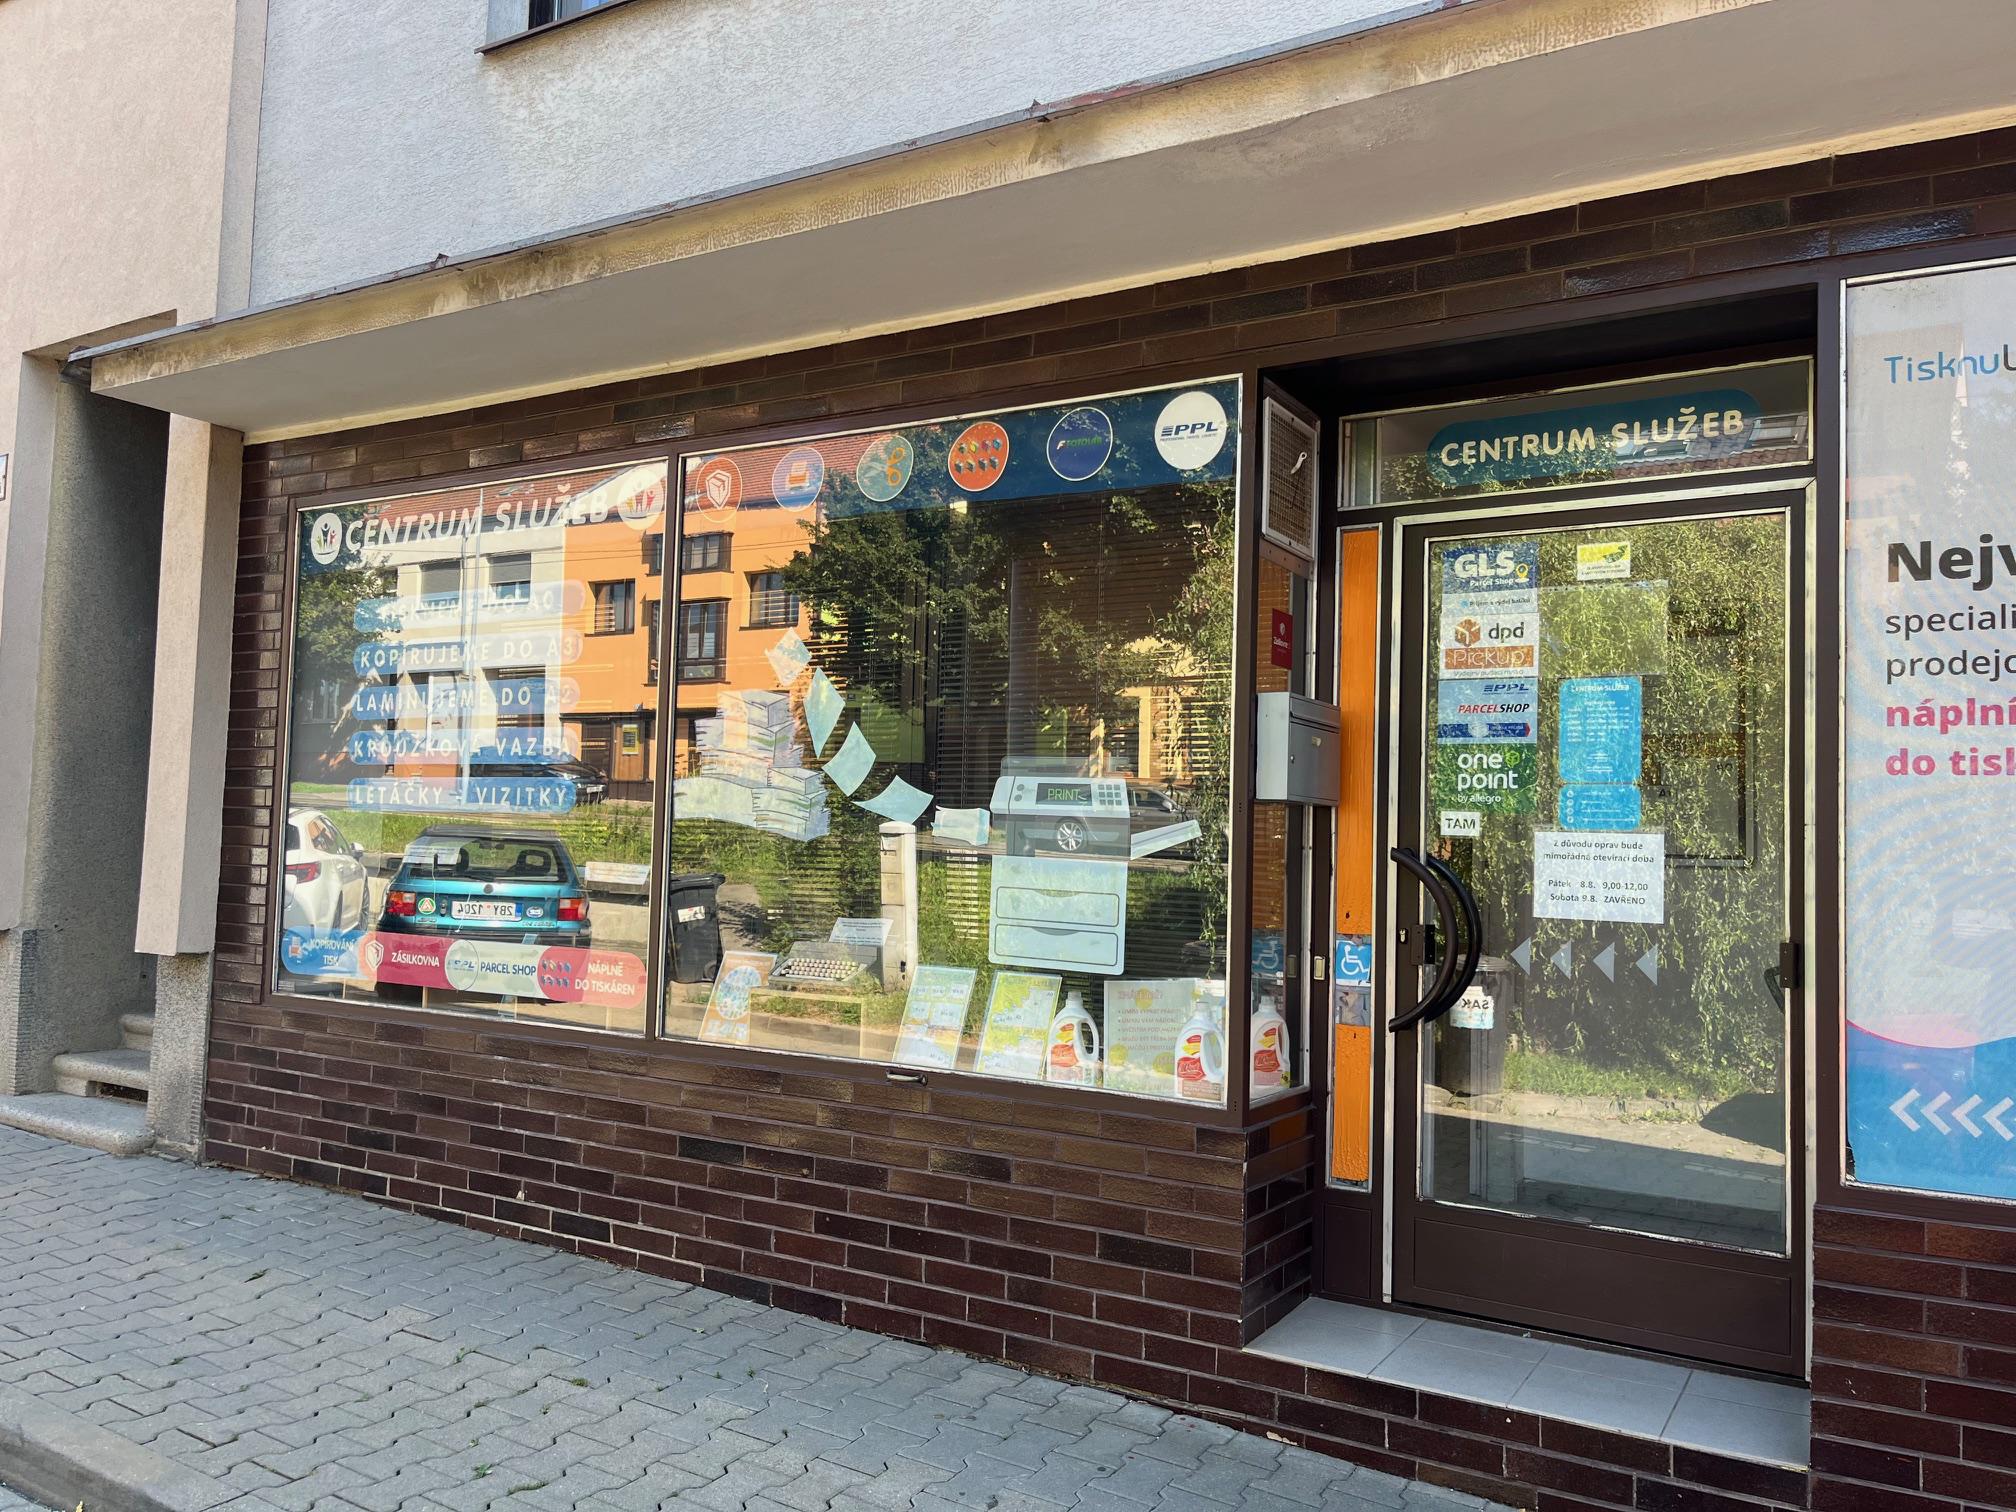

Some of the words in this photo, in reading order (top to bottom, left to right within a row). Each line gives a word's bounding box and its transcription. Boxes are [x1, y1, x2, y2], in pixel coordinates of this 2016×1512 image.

[1173, 421, 1219, 436] PPL
[1440, 427, 1596, 467] CENTRUM
[1610, 405, 1745, 449] SLUŽEB
[345, 506, 483, 550] CENTRUM
[494, 483, 609, 532] SLUŽEB
[1454, 550, 1515, 579] GLS
[1494, 578, 1514, 587] Shop
[1488, 621, 1525, 643] dpd
[503, 639, 533, 658] DO
[546, 637, 573, 657] A3
[1494, 683, 1529, 692] PPL
[501, 686, 531, 706] DO
[1458, 703, 1530, 714] PARCELSHOP
[496, 736, 571, 757] VAZBA
[1457, 753, 1503, 769] one
[1885, 748, 1936, 777] do
[1457, 770, 1519, 791] point
[355, 782, 443, 806] LETÁČKY
[476, 786, 567, 806] VIZITKY
[1047, 788, 1081, 800] PRINT
[1457, 794, 1468, 804] by
[1469, 793, 1502, 805] allegro
[1445, 818, 1476, 829] TAM
[1561, 839, 1592, 848] důvodu
[1594, 841, 1619, 850] oprav
[1621, 841, 1643, 850] bude
[1543, 852, 1591, 861] mimořádná
[1632, 854, 1655, 863] doba
[1548, 879, 1572, 888] Pátek
[1550, 893, 1579, 901] Sobota
[1582, 894, 1598, 902] 9.8.
[1603, 893, 1646, 905] ZAVŘENO
[322, 954, 340, 967] TISK
[391, 949, 440, 968] ZÁSILKOVNA
[480, 962, 511, 975] PARCEL
[511, 963, 537, 977] SHOP
[574, 978, 590, 991] DO
[591, 978, 636, 996] TISKÁREN
